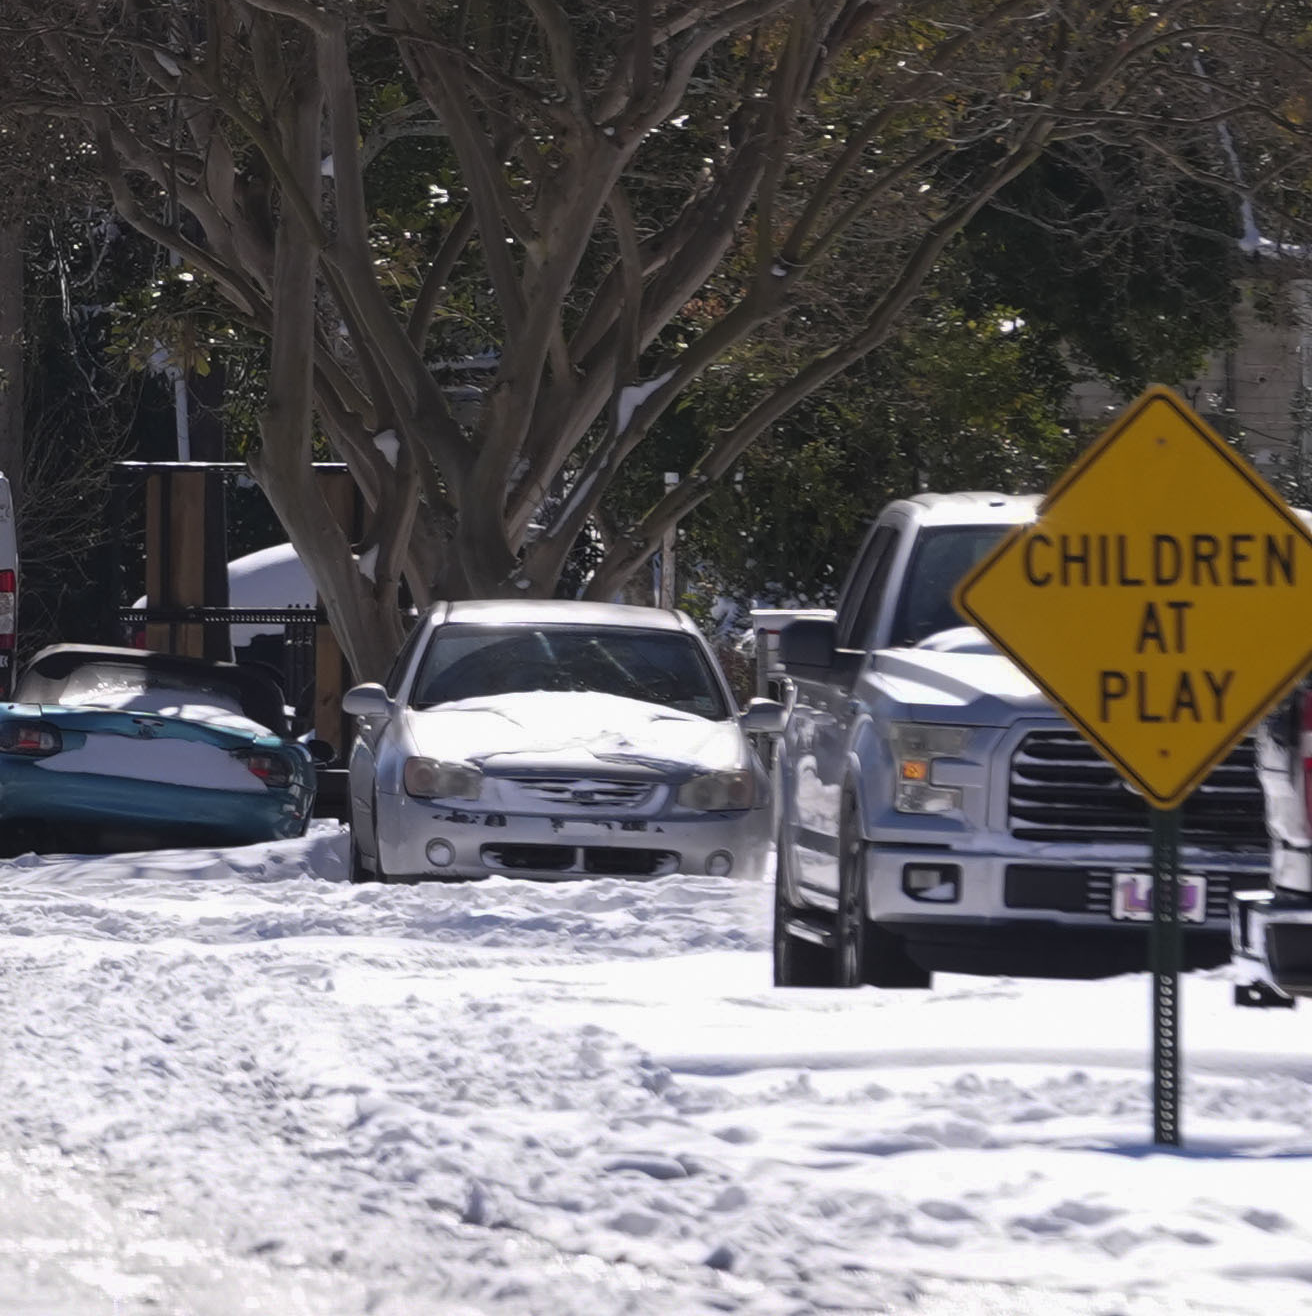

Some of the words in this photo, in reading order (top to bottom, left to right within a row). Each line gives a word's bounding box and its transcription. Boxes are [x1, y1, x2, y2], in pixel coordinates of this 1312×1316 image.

[1024, 533, 1297, 586] CHILDREN
[1135, 601, 1194, 654] AT
[1098, 670, 1235, 723] PLAY
